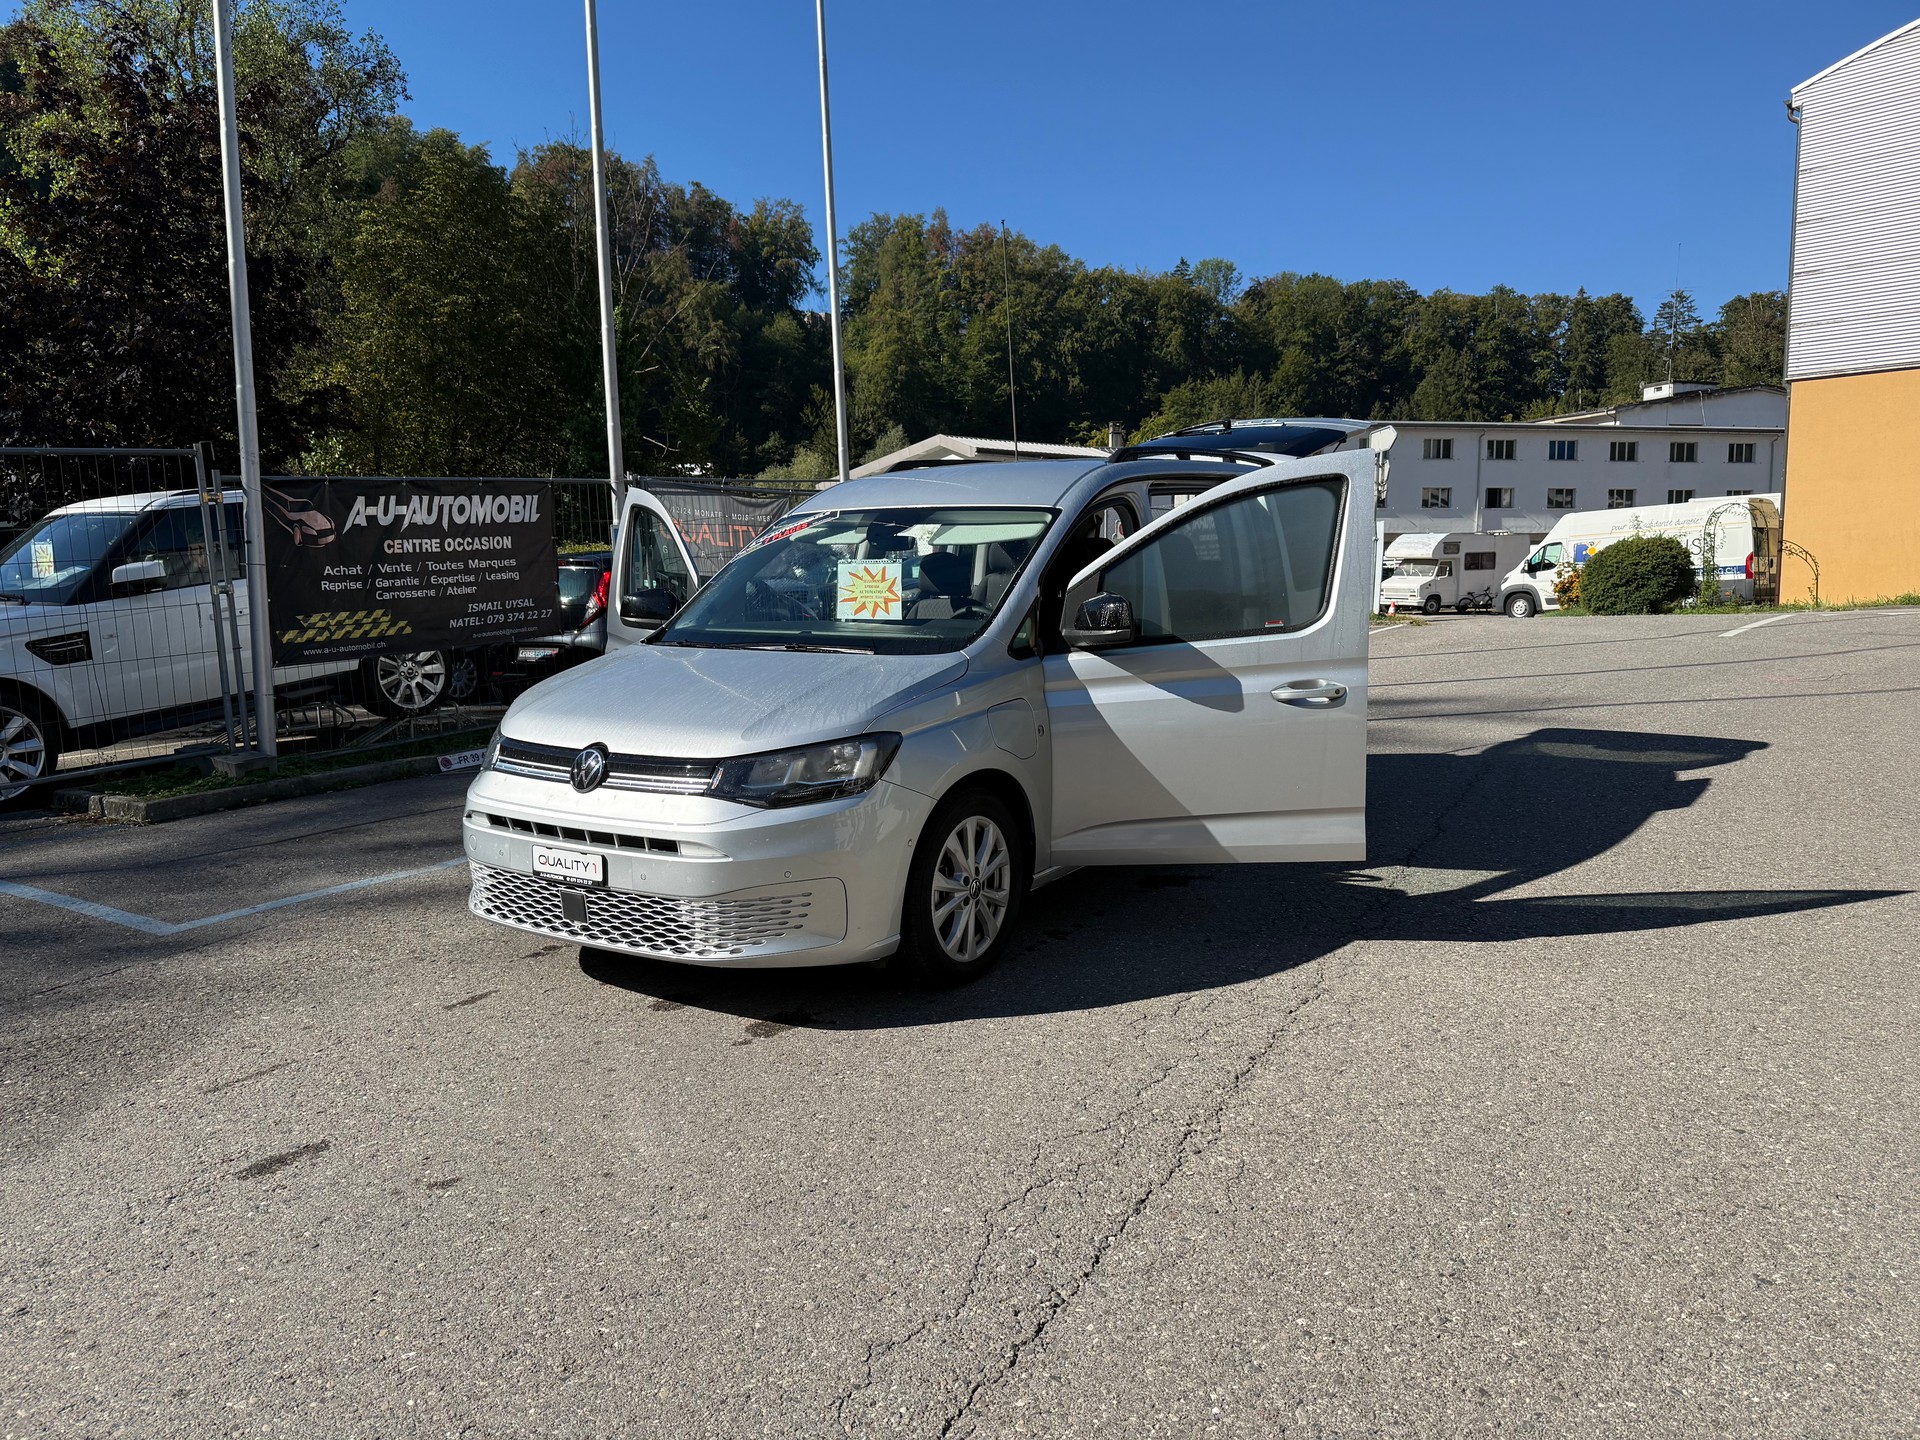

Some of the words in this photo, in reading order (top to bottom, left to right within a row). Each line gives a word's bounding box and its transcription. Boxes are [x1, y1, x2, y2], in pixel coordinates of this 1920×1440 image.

[343, 494, 541, 535] A-U-AUTOMOBIL
[694, 509, 722, 518] MONATE
[731, 513, 749, 521] MOIS
[771, 522, 809, 541] PLACES
[383, 538, 441, 555] CENTRE
[444, 535, 513, 552] OCCASION
[323, 563, 363, 576] Achat
[378, 562, 412, 573] Vente
[426, 559, 464, 571] Toutes
[468, 557, 517, 570] Marques
[320, 580, 363, 593] Reprise
[375, 577, 420, 589] Garantie
[431, 573, 475, 586] Expertise
[485, 570, 520, 583] Leasing
[376, 588, 436, 600] Carrosserie
[446, 585, 477, 597] Atelier
[467, 601, 503, 613] ISMAIL
[505, 598, 535, 609] UYSAL
[449, 616, 484, 629] NATEL:
[487, 613, 505, 625] 079
[506, 611, 525, 623] 374
[527, 610, 539, 621] 22
[541, 609, 553, 619] 27
[303, 641, 386, 656] www.a-u-automobil.ch
[458, 756, 470, 765] FR
[471, 753, 480, 762] 39
[538, 854, 590, 873] QUALITY
[592, 863, 597, 874] 1
